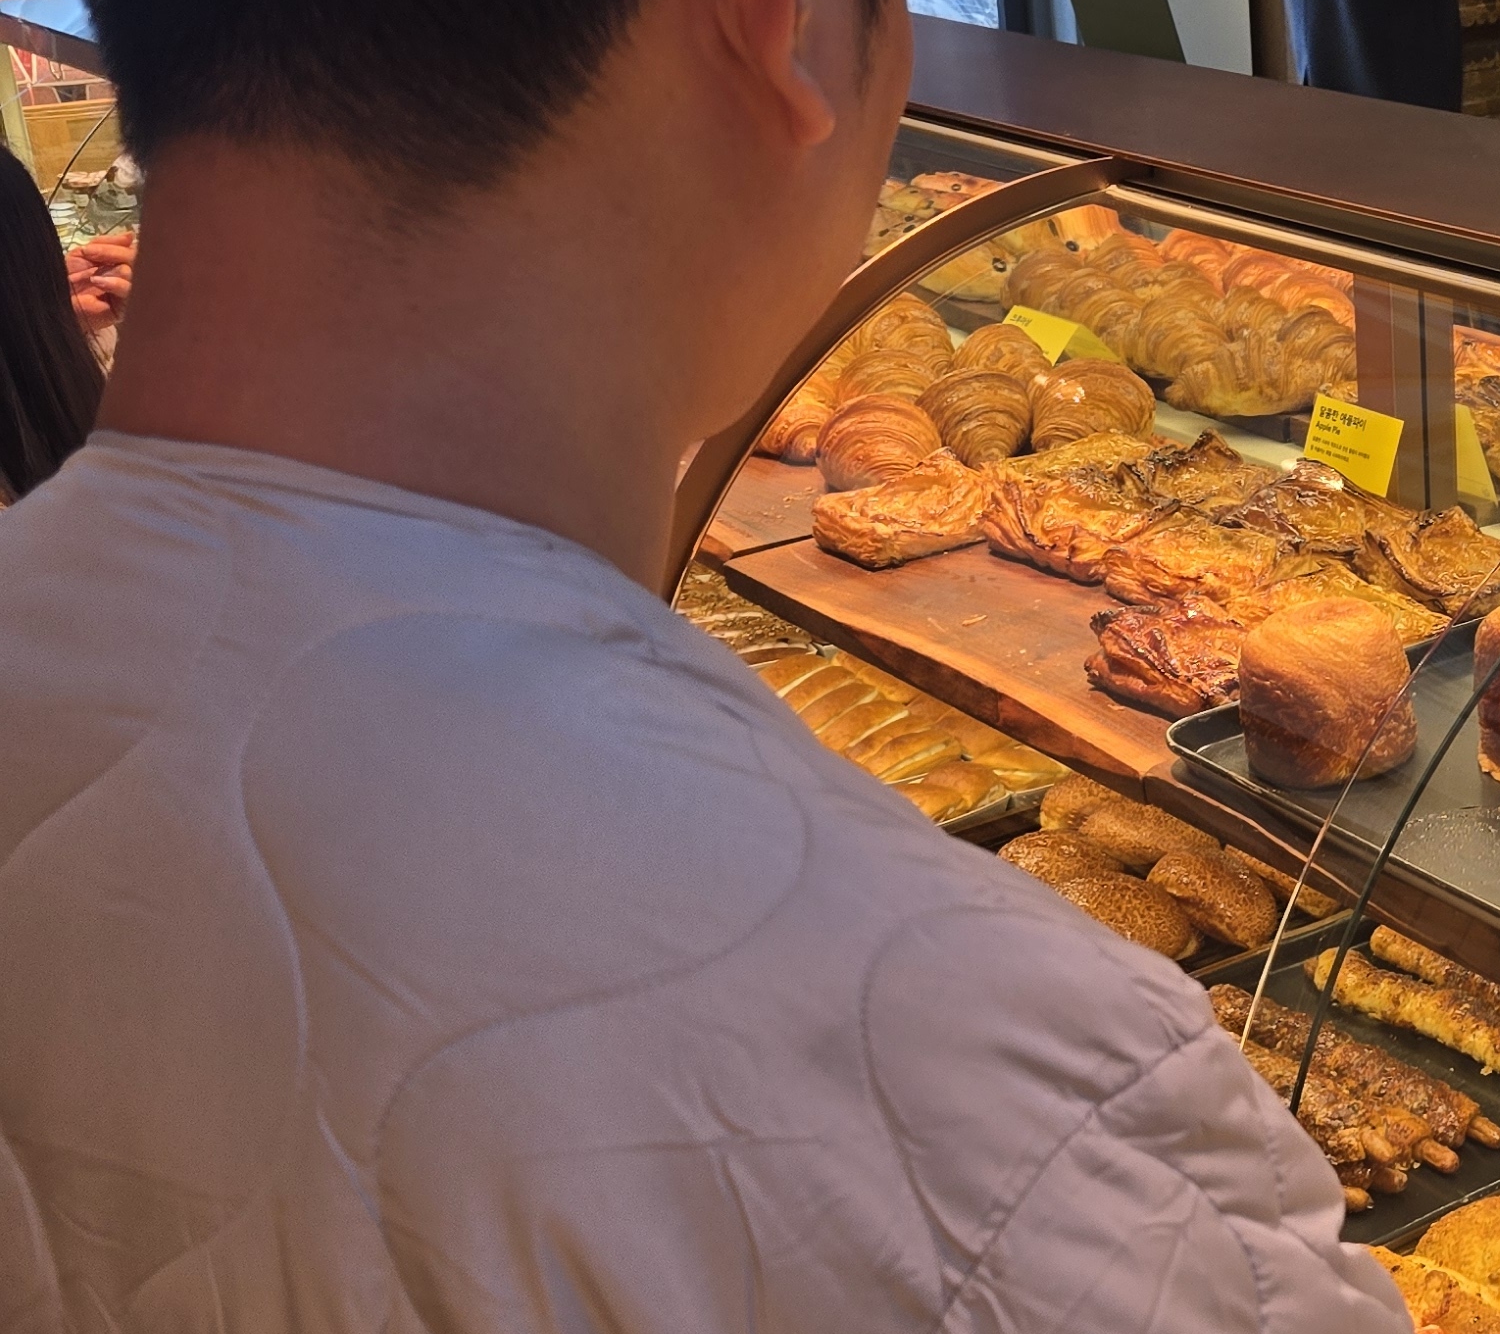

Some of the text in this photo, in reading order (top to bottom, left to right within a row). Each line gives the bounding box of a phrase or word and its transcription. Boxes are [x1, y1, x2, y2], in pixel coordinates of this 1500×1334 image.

[1315, 420, 1341, 435] Apple Pie
[1339, 412, 1367, 432] 애플파이
